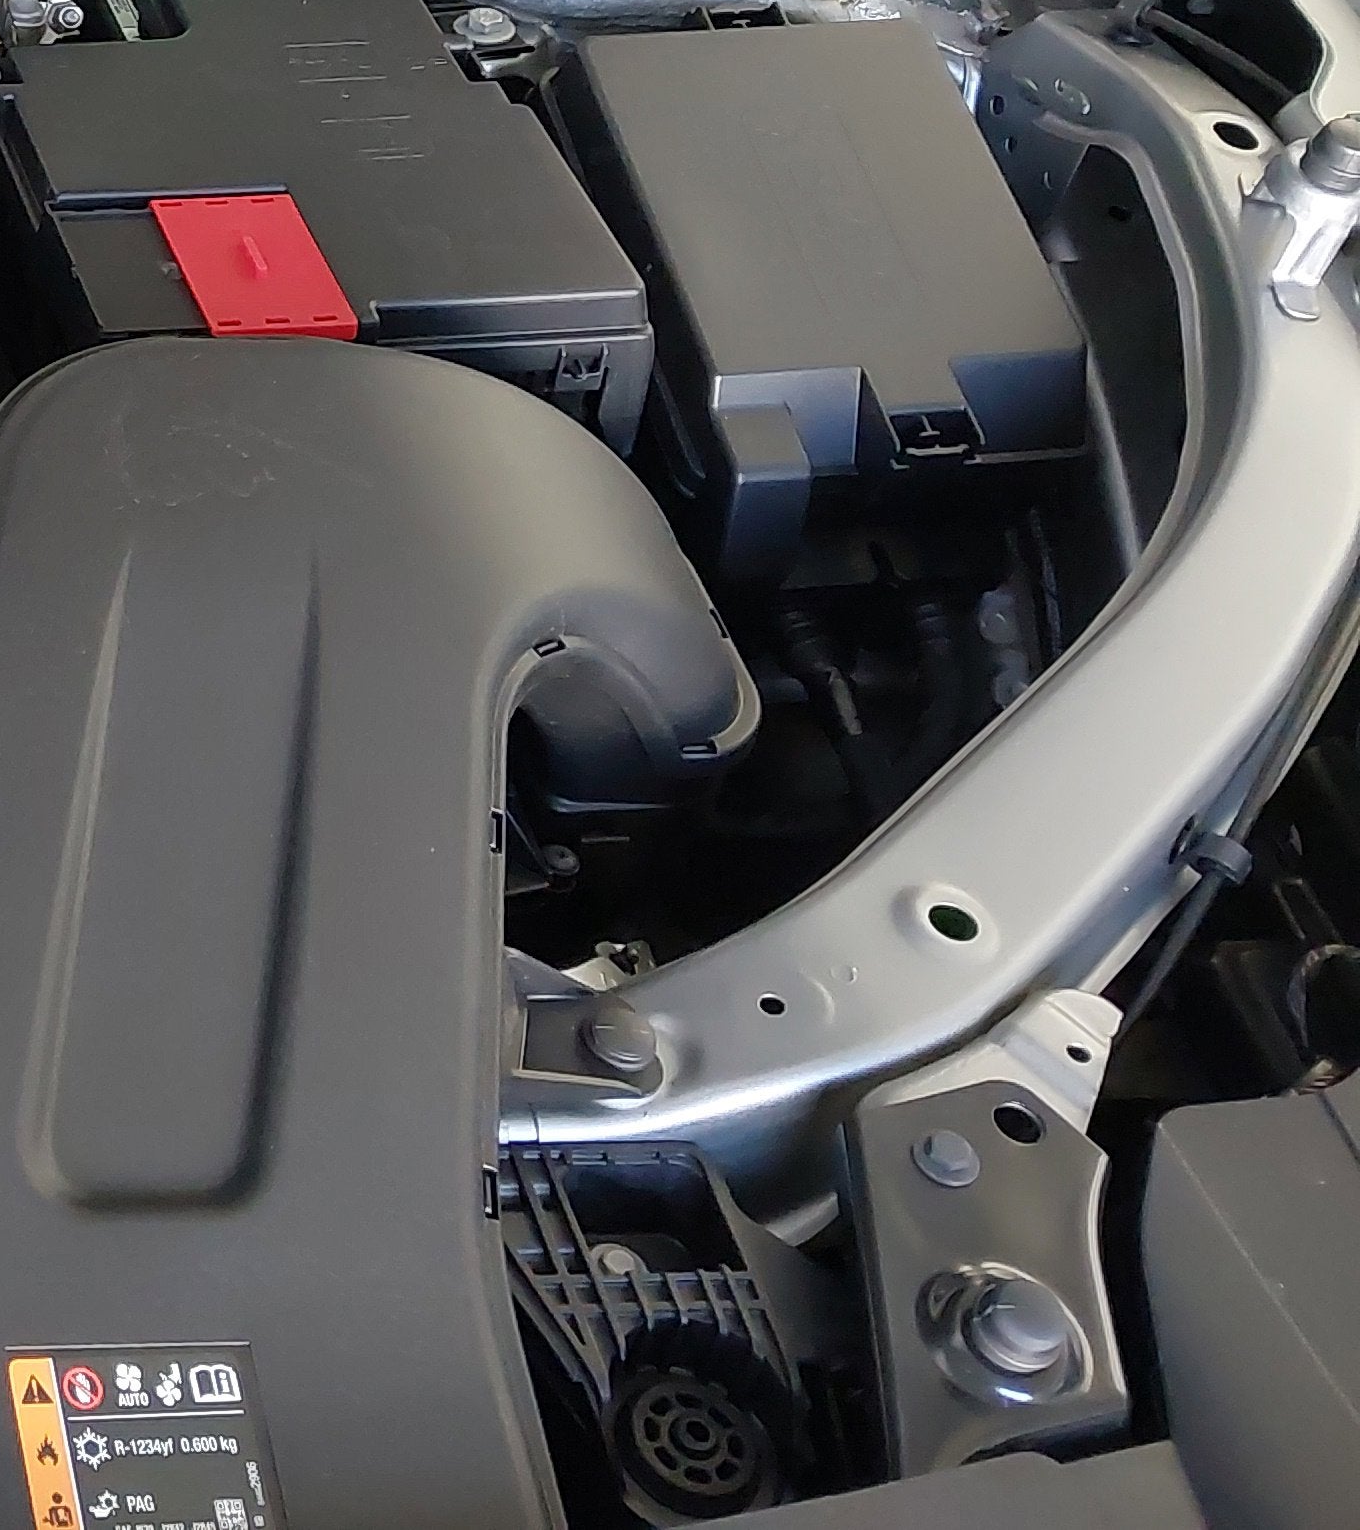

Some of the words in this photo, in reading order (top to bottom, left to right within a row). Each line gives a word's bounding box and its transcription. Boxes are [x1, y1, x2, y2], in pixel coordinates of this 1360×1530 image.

[118, 1392, 150, 1407] AUTO
[113, 1437, 174, 1458] R-1234yf
[180, 1436, 218, 1453] 0.600
[219, 1435, 238, 1455] kg
[126, 1494, 155, 1513] PAG
